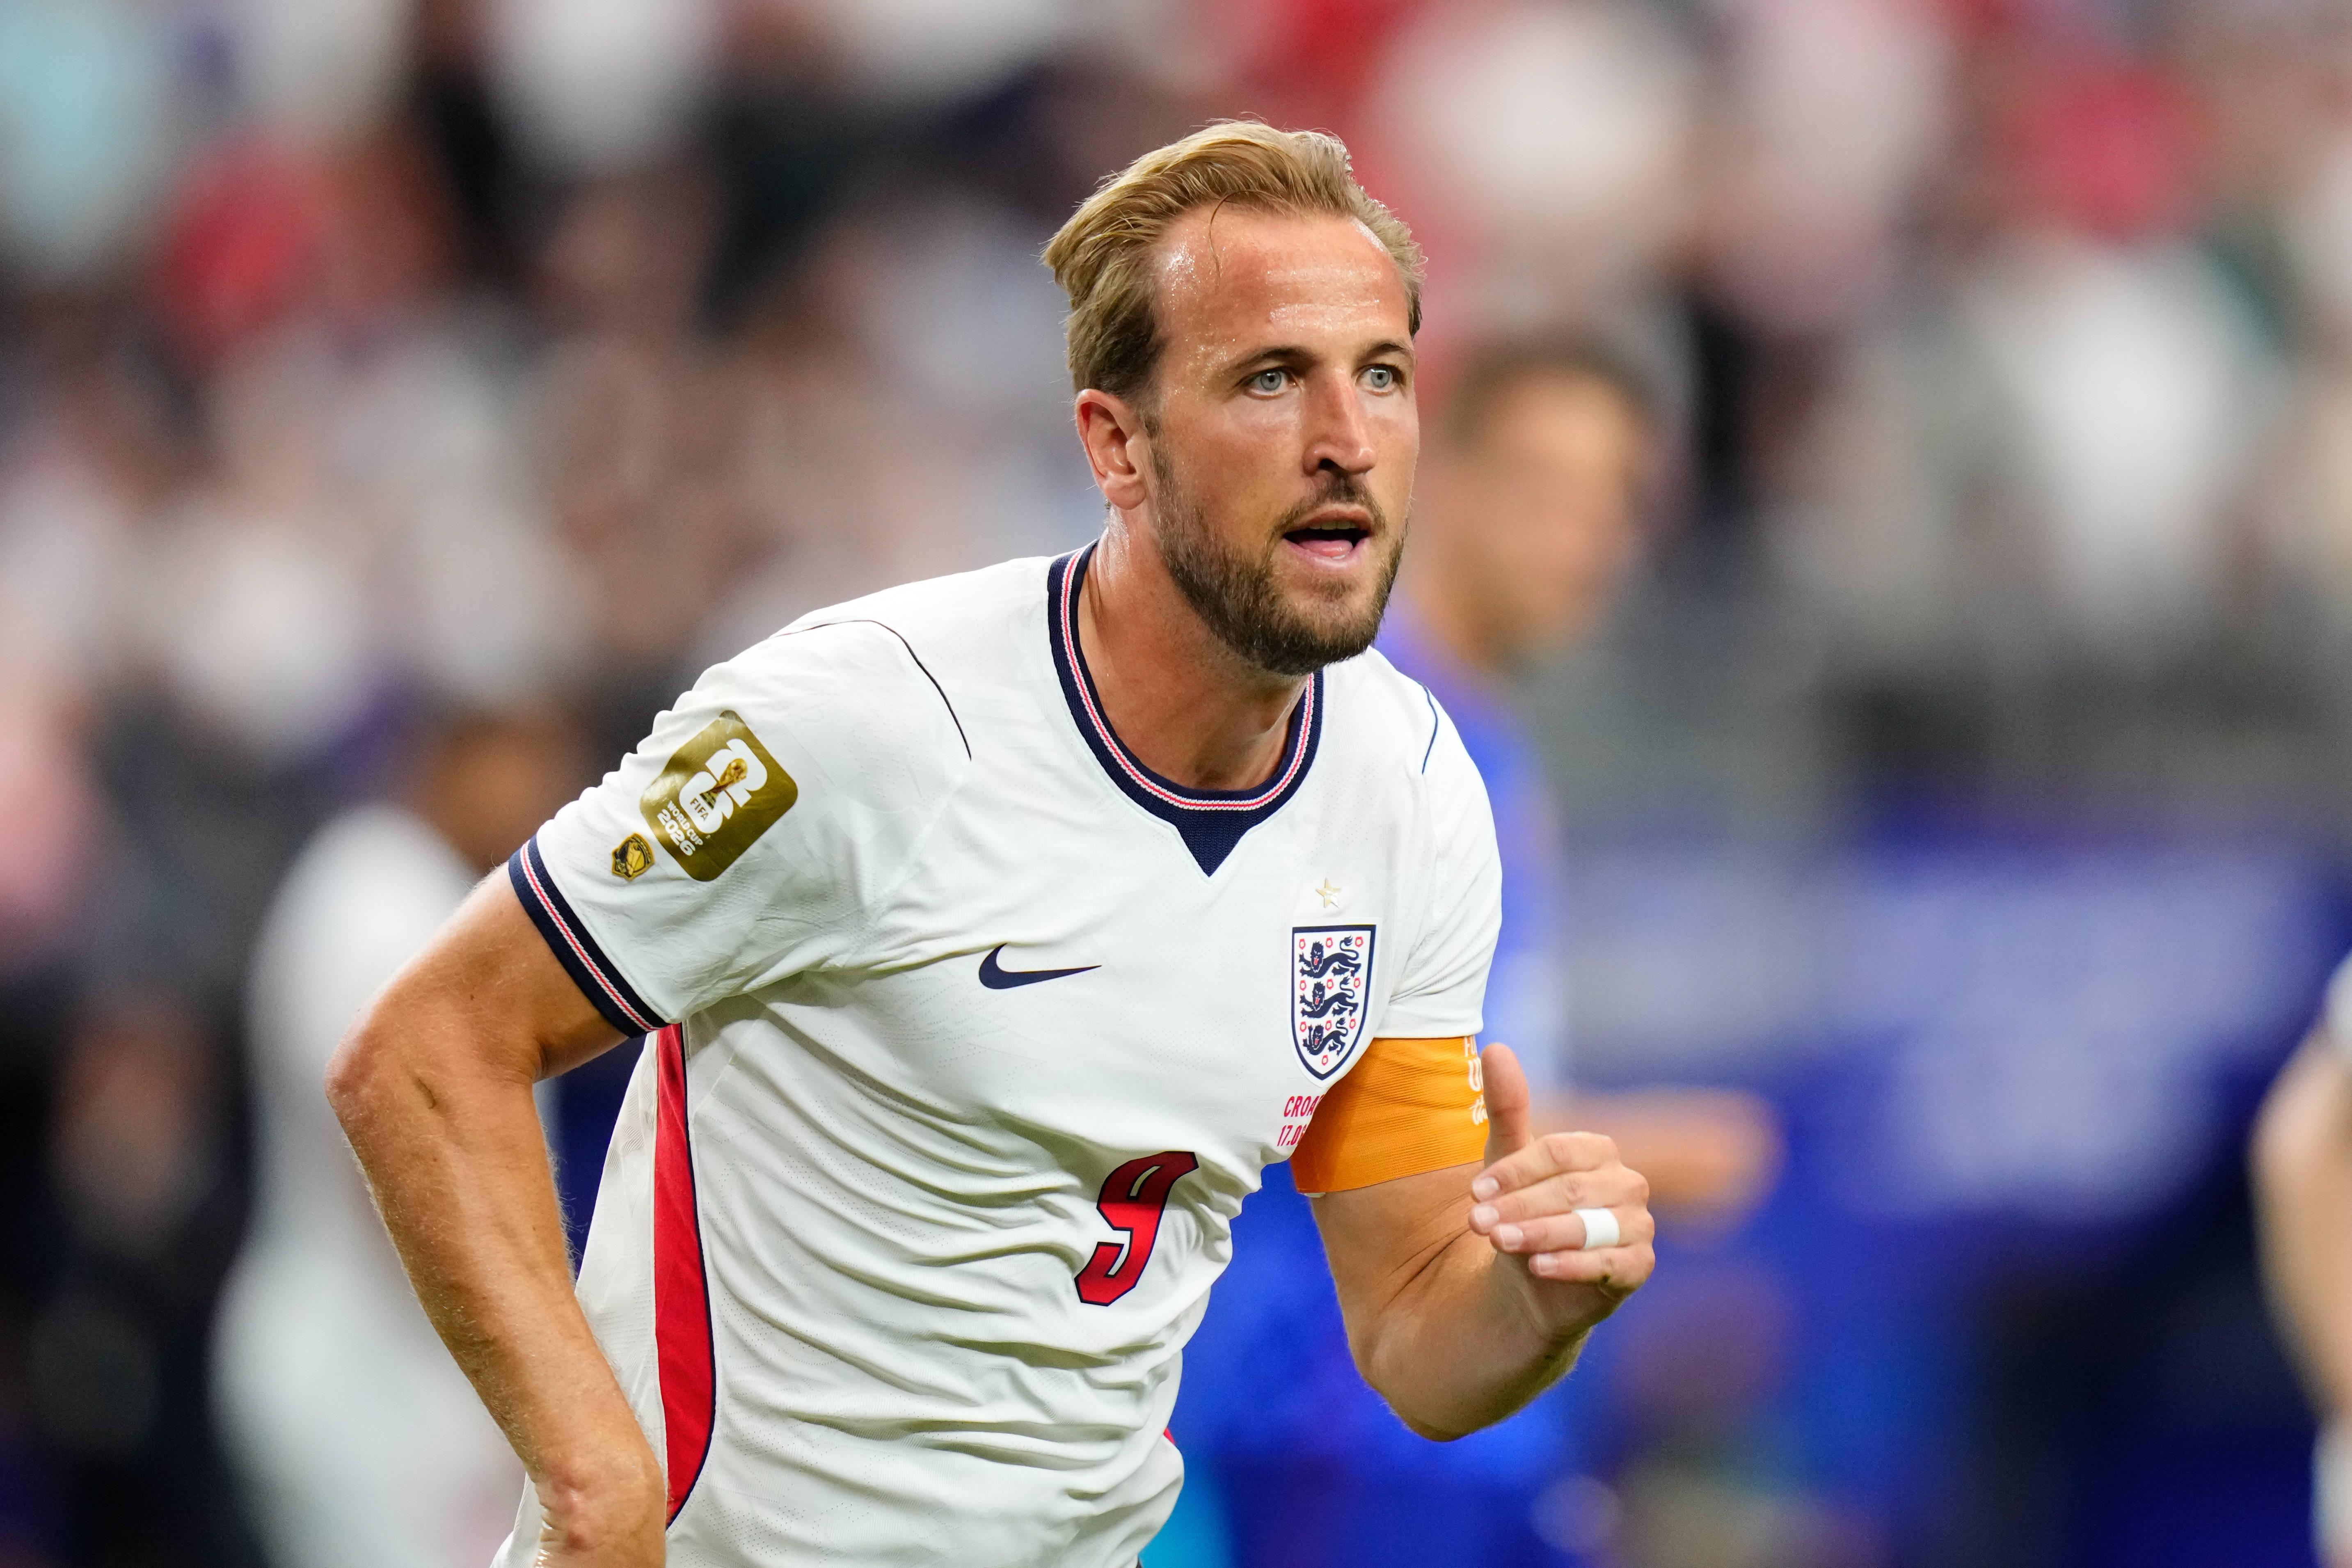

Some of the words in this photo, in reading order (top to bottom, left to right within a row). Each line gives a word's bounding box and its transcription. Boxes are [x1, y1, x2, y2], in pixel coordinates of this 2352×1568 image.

[668, 800, 690, 830] WORLD
[686, 829, 703, 845] CUP
[690, 798, 709, 821] FIFA
[657, 809, 696, 856] 2026
[1284, 1094, 1325, 1117] CROA
[1074, 1151, 1199, 1307] 9
